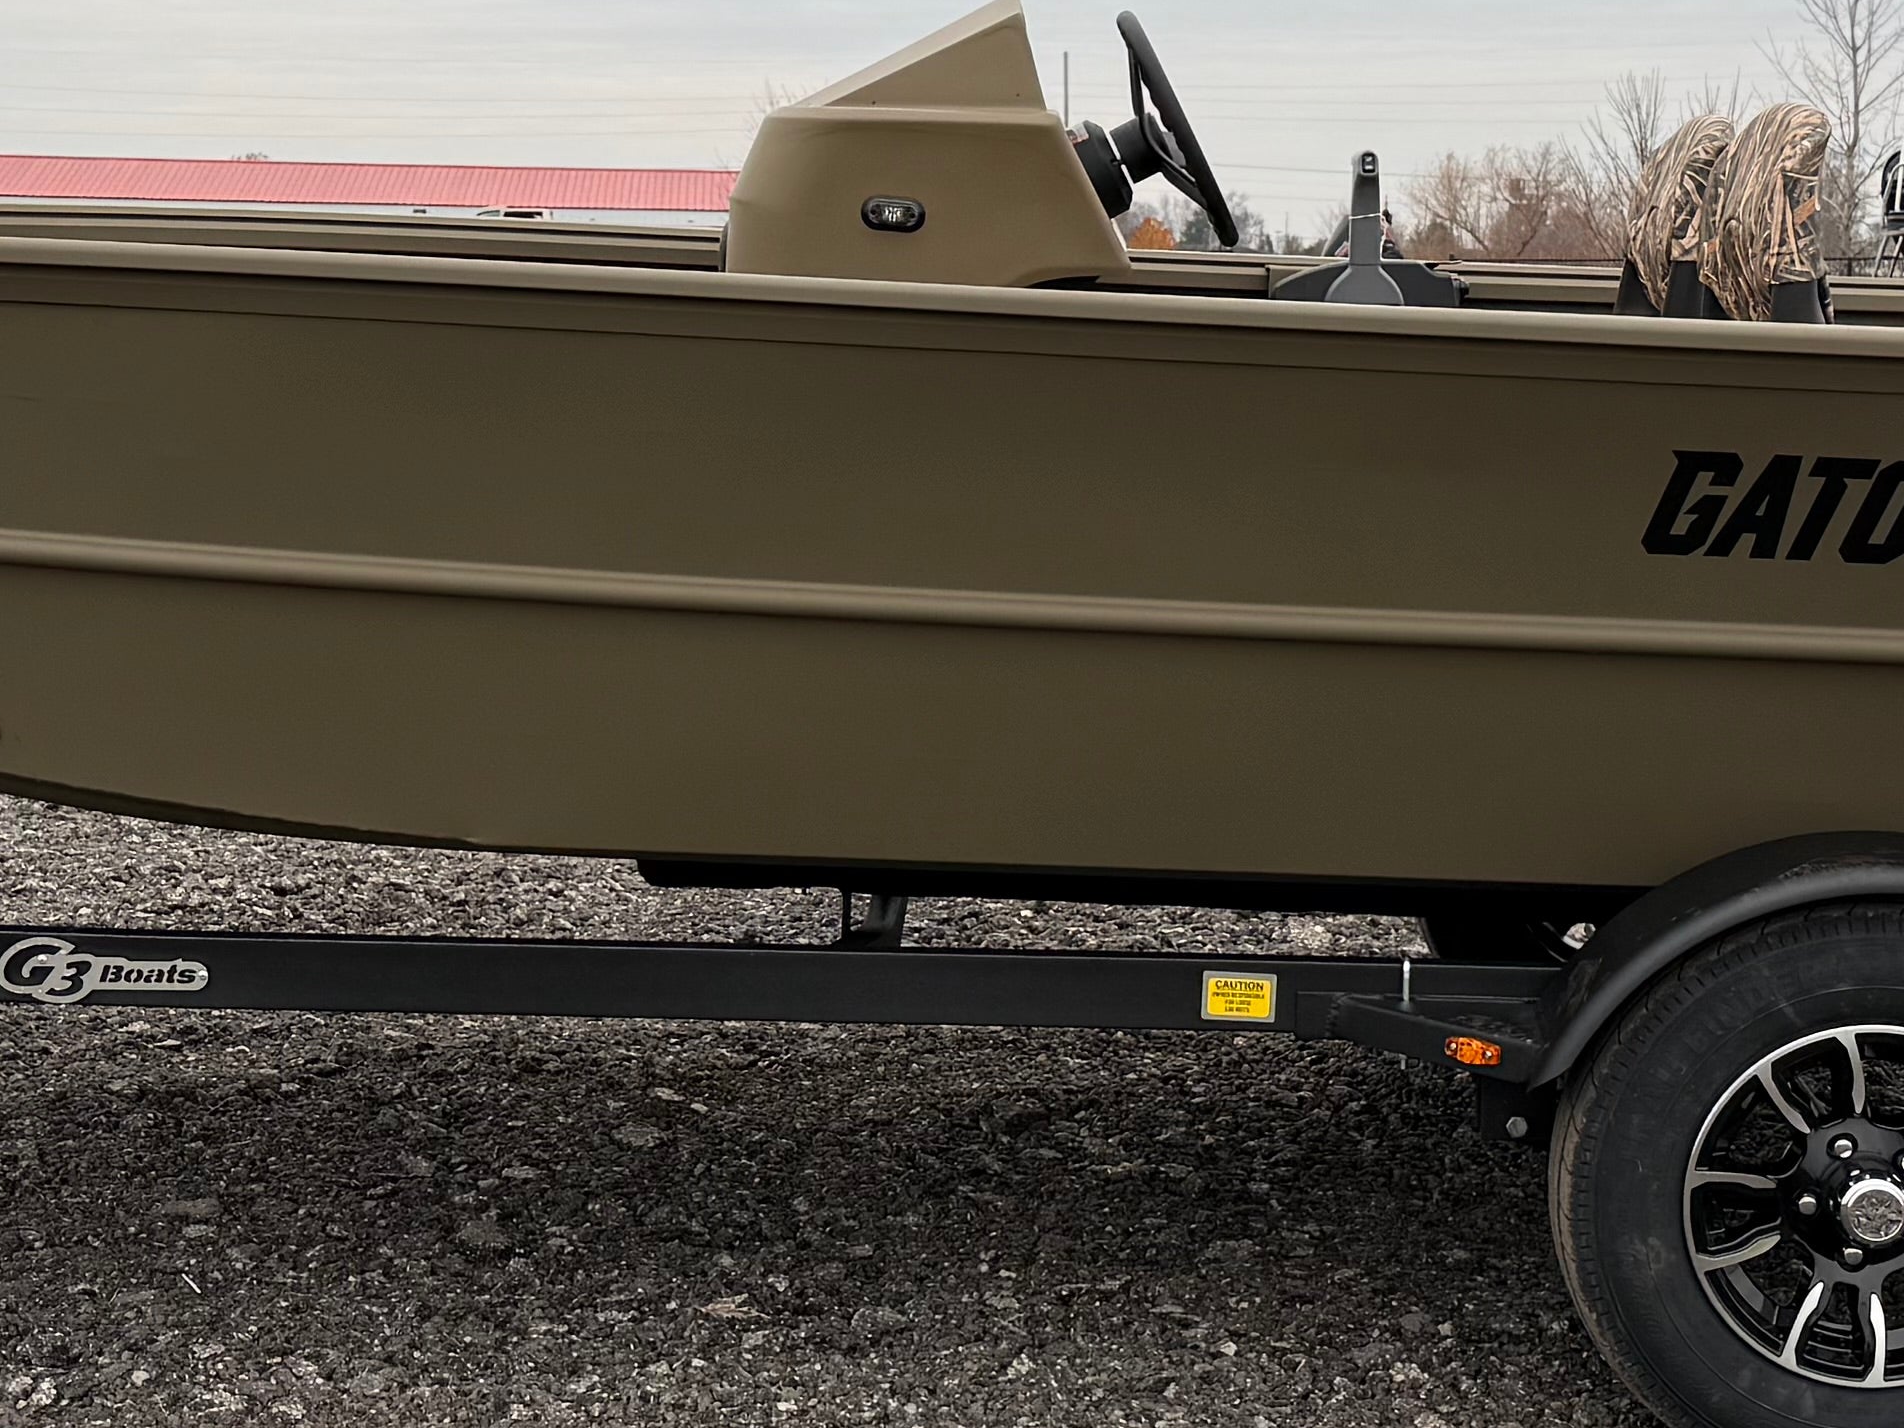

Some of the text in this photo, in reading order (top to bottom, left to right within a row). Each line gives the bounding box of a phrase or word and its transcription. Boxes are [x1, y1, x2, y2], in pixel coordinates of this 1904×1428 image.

[3, 943, 196, 996] G3 Boats
[1215, 980, 1264, 992] CAUTION
